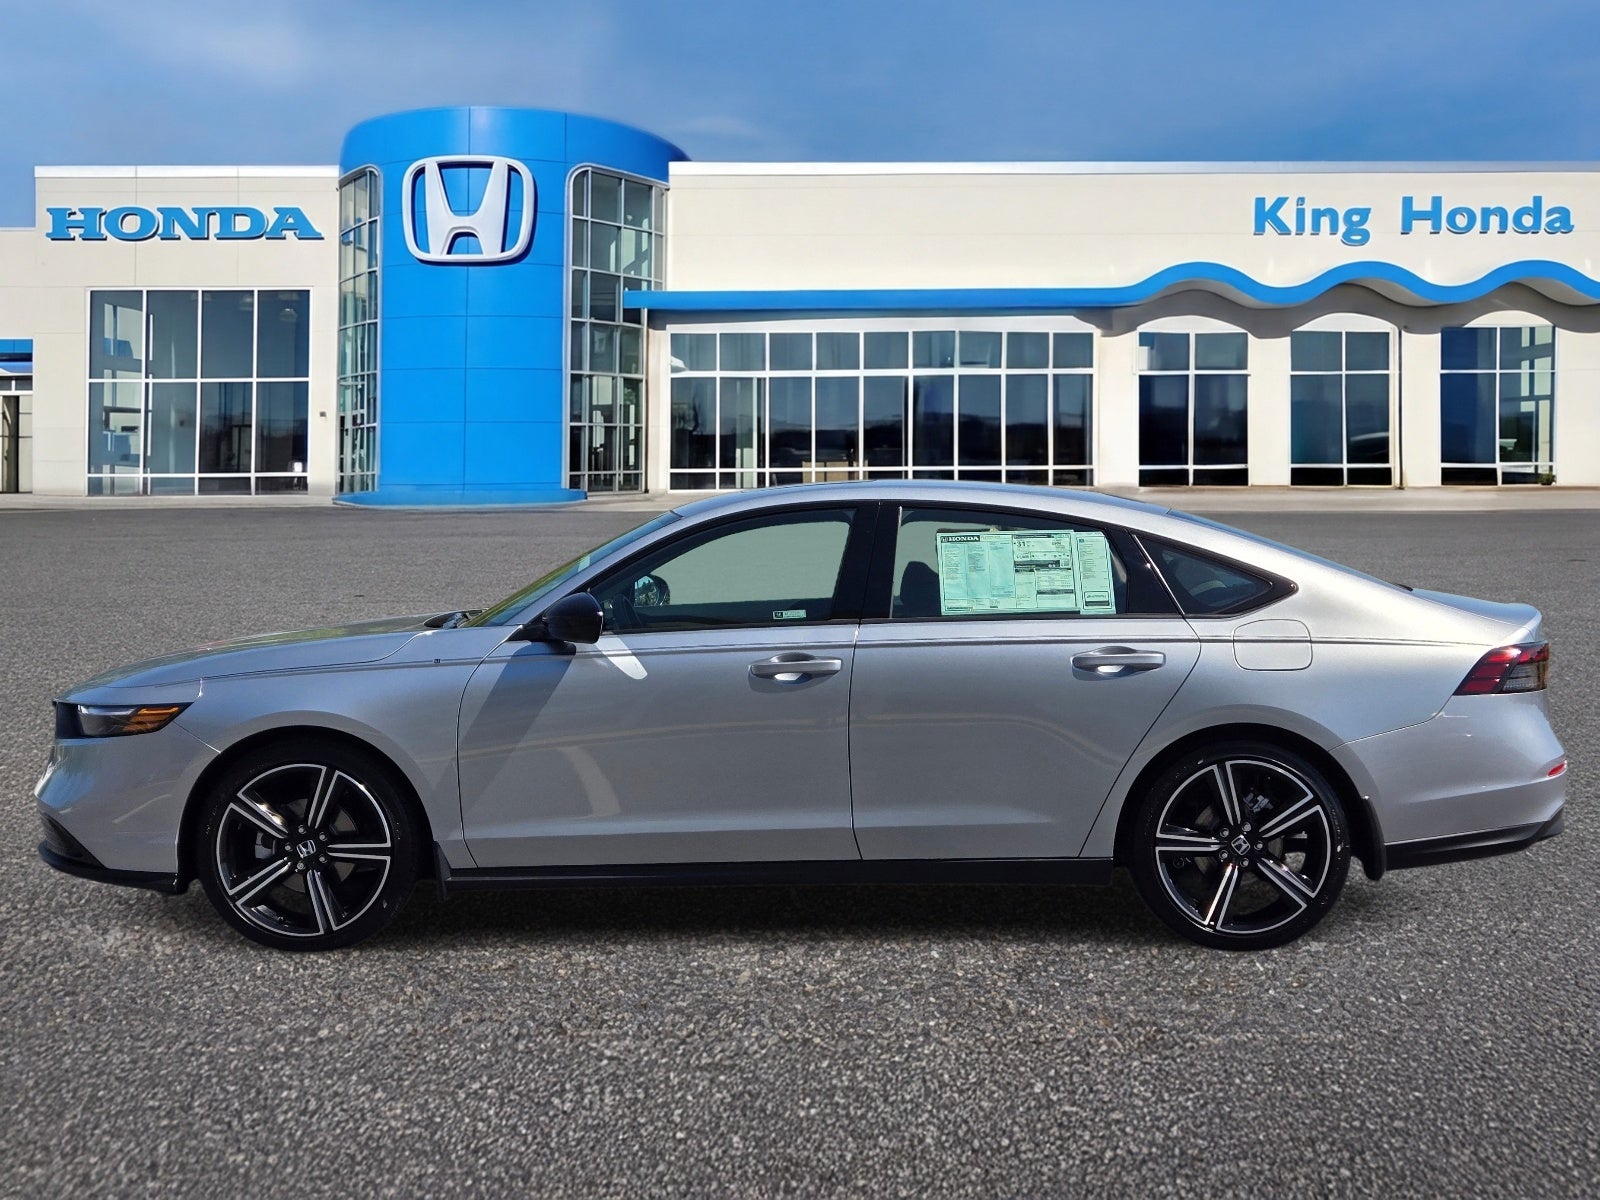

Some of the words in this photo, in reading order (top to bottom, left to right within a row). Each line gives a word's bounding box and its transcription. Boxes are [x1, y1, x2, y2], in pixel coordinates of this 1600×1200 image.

[45, 206, 325, 241] HONDA
[1253, 196, 1371, 247] King
[1400, 195, 1575, 235] Honda
